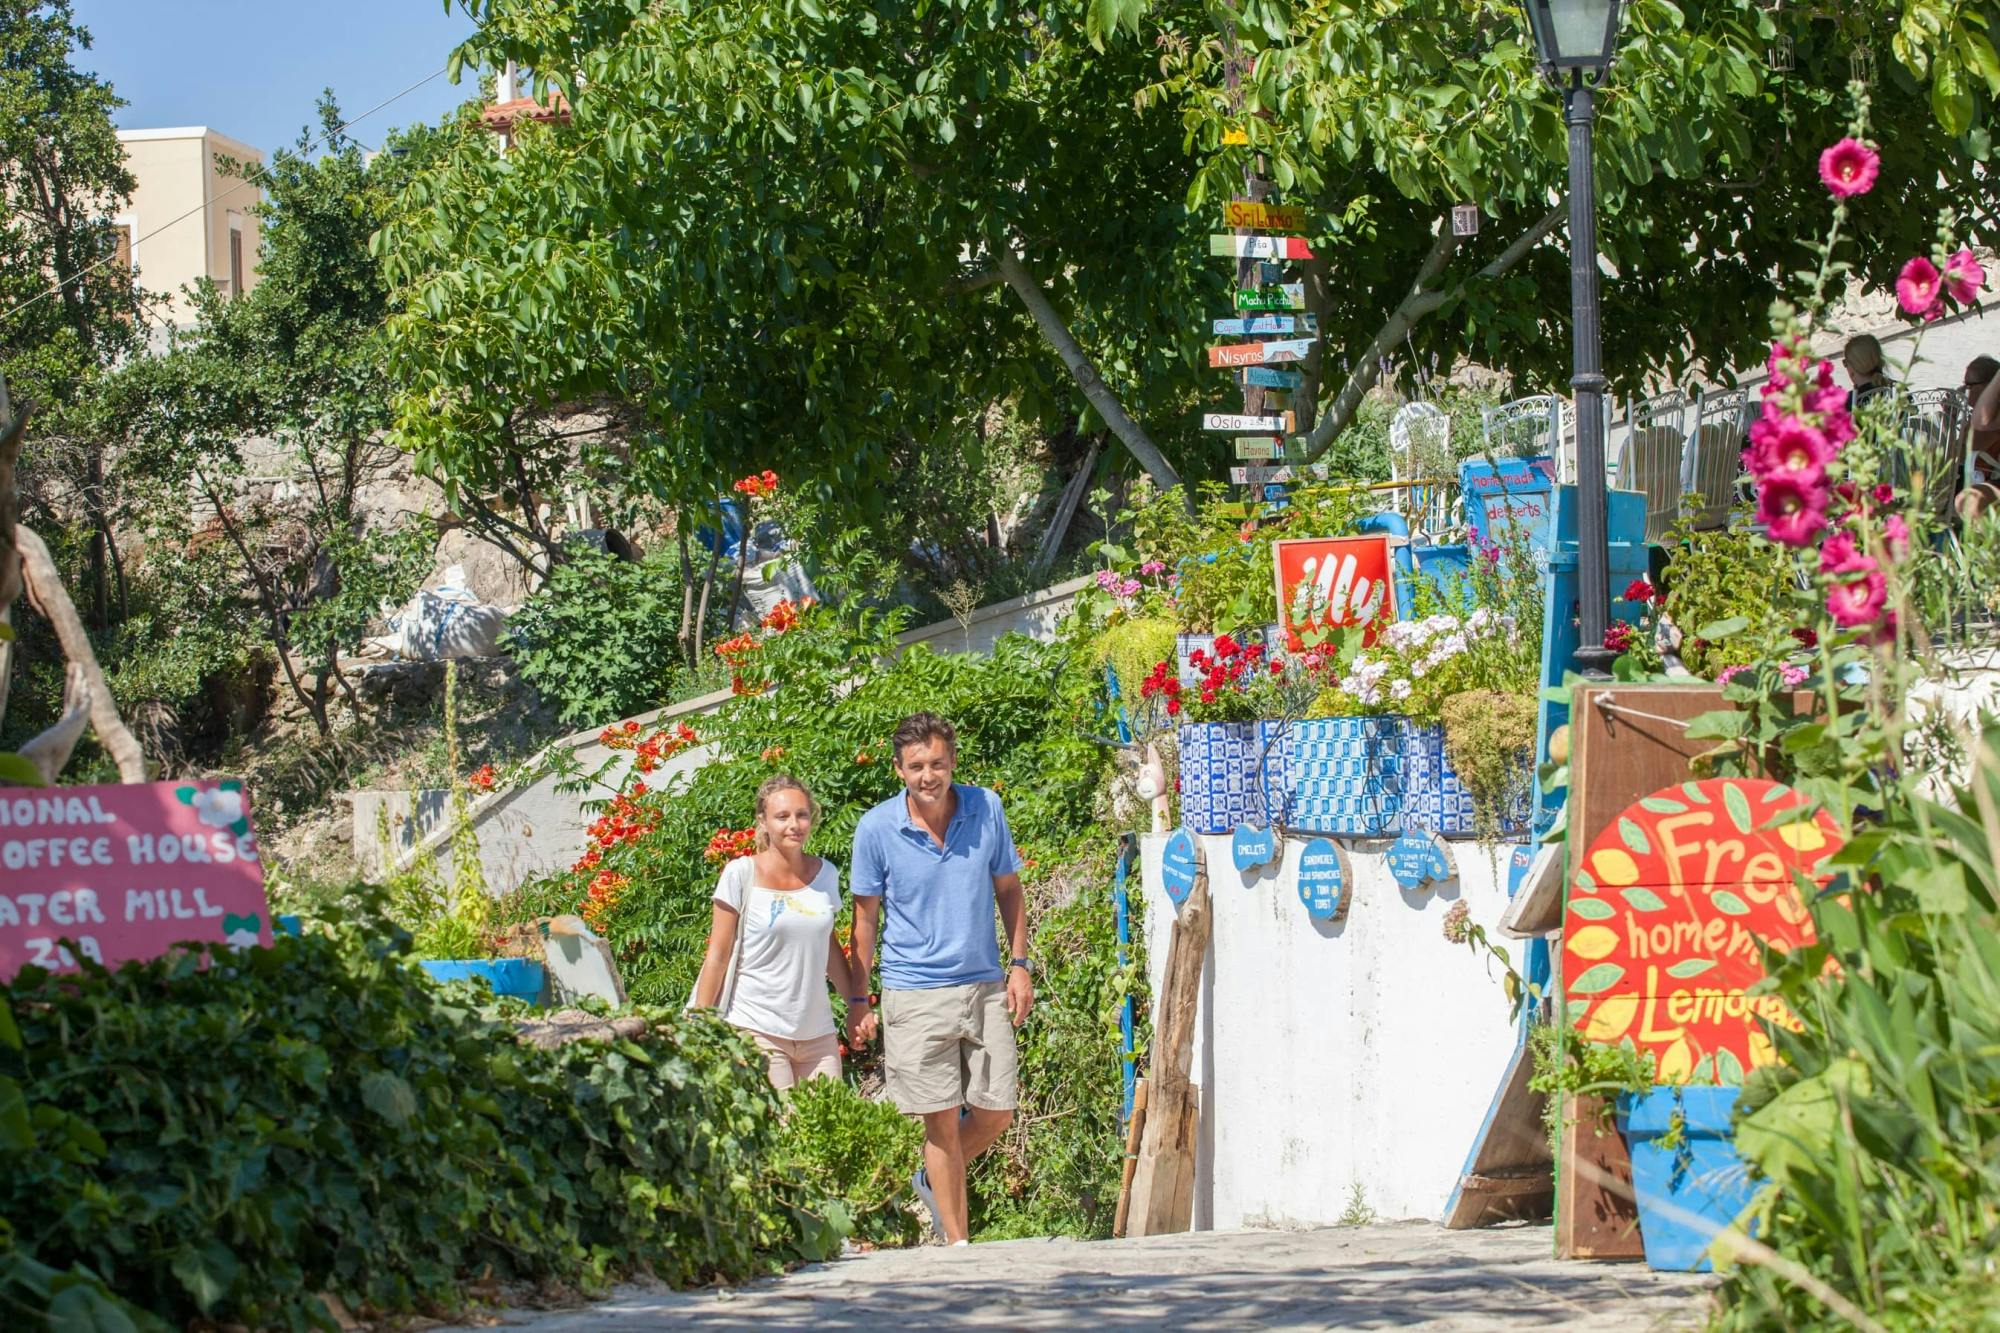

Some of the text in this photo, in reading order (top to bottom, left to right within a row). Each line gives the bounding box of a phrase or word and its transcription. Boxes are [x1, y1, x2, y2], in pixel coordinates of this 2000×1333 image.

[1249, 238, 1267, 249] Pisa
[1239, 294, 1266, 306] Machu
[1218, 349, 1263, 366] Nisyros
[1211, 415, 1242, 429] Oslo
[1487, 502, 1541, 520] deserts
[0, 832, 258, 870] OFFEE HOUSE
[125, 887, 224, 922] MILL
